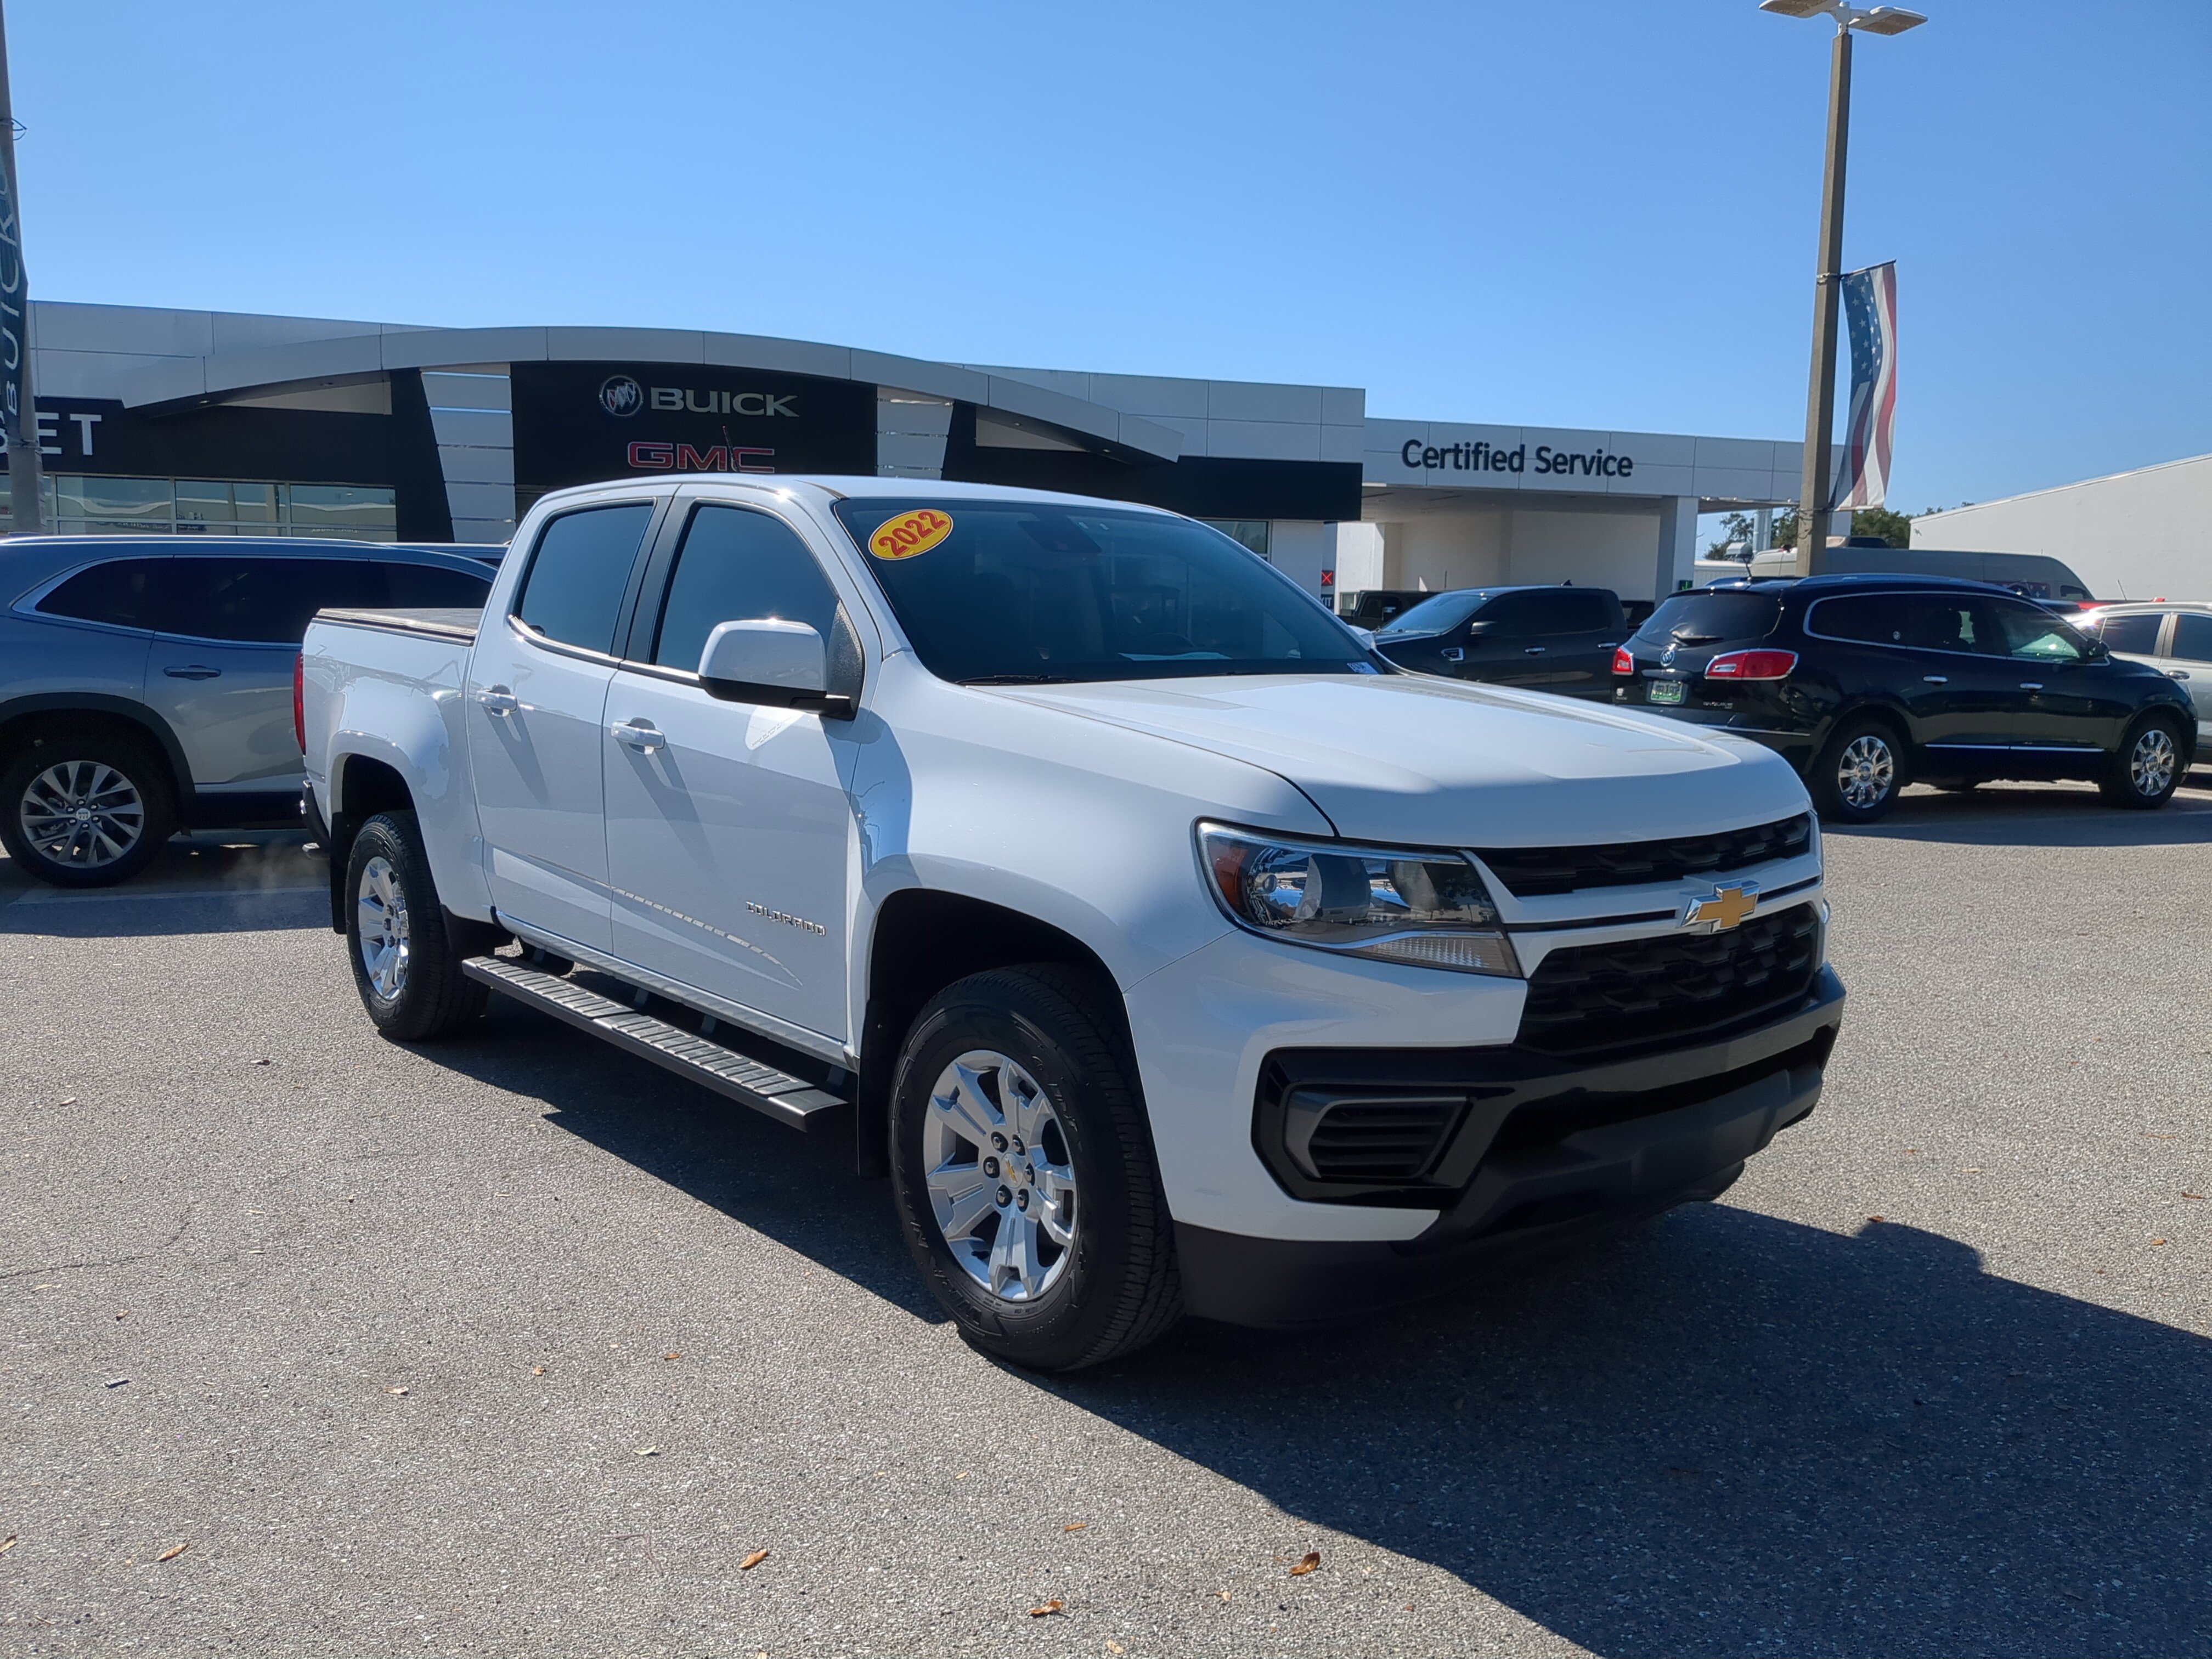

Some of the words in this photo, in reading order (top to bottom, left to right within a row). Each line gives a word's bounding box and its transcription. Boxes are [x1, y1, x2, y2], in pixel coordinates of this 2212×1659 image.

[651, 386, 799, 417] BUICK
[627, 441, 775, 473] GMC
[1402, 439, 1525, 473] Certified
[1534, 445, 1633, 477] Service
[878, 511, 948, 557] 2022
[745, 900, 827, 936] COLORADO
